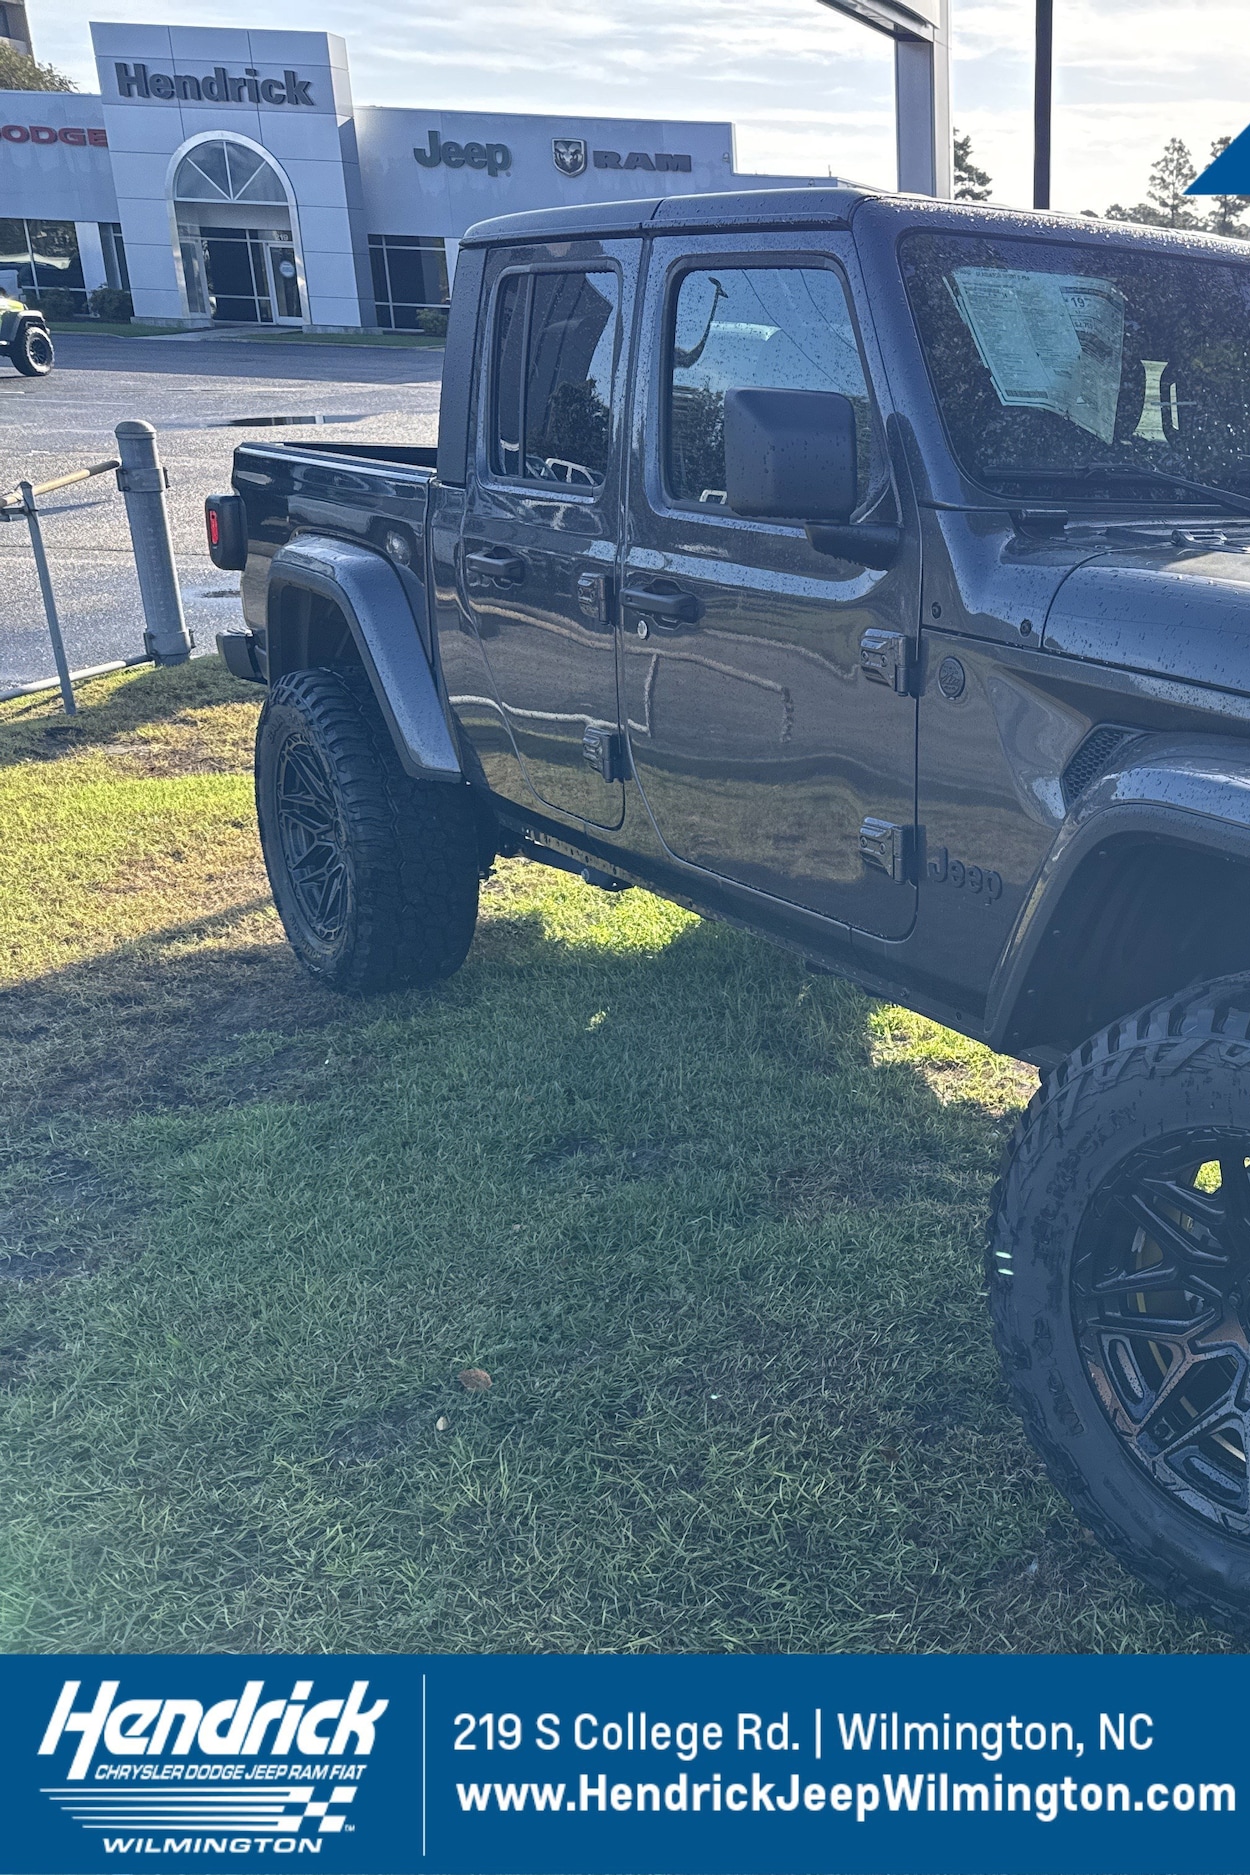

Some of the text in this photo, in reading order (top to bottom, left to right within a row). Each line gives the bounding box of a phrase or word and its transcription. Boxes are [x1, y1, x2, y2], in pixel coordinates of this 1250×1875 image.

[114, 63, 314, 106] Hendrick
[0, 124, 108, 148] ODGE
[413, 130, 511, 177] Jeep
[593, 150, 692, 172] RAM
[927, 846, 1003, 906] Jeep
